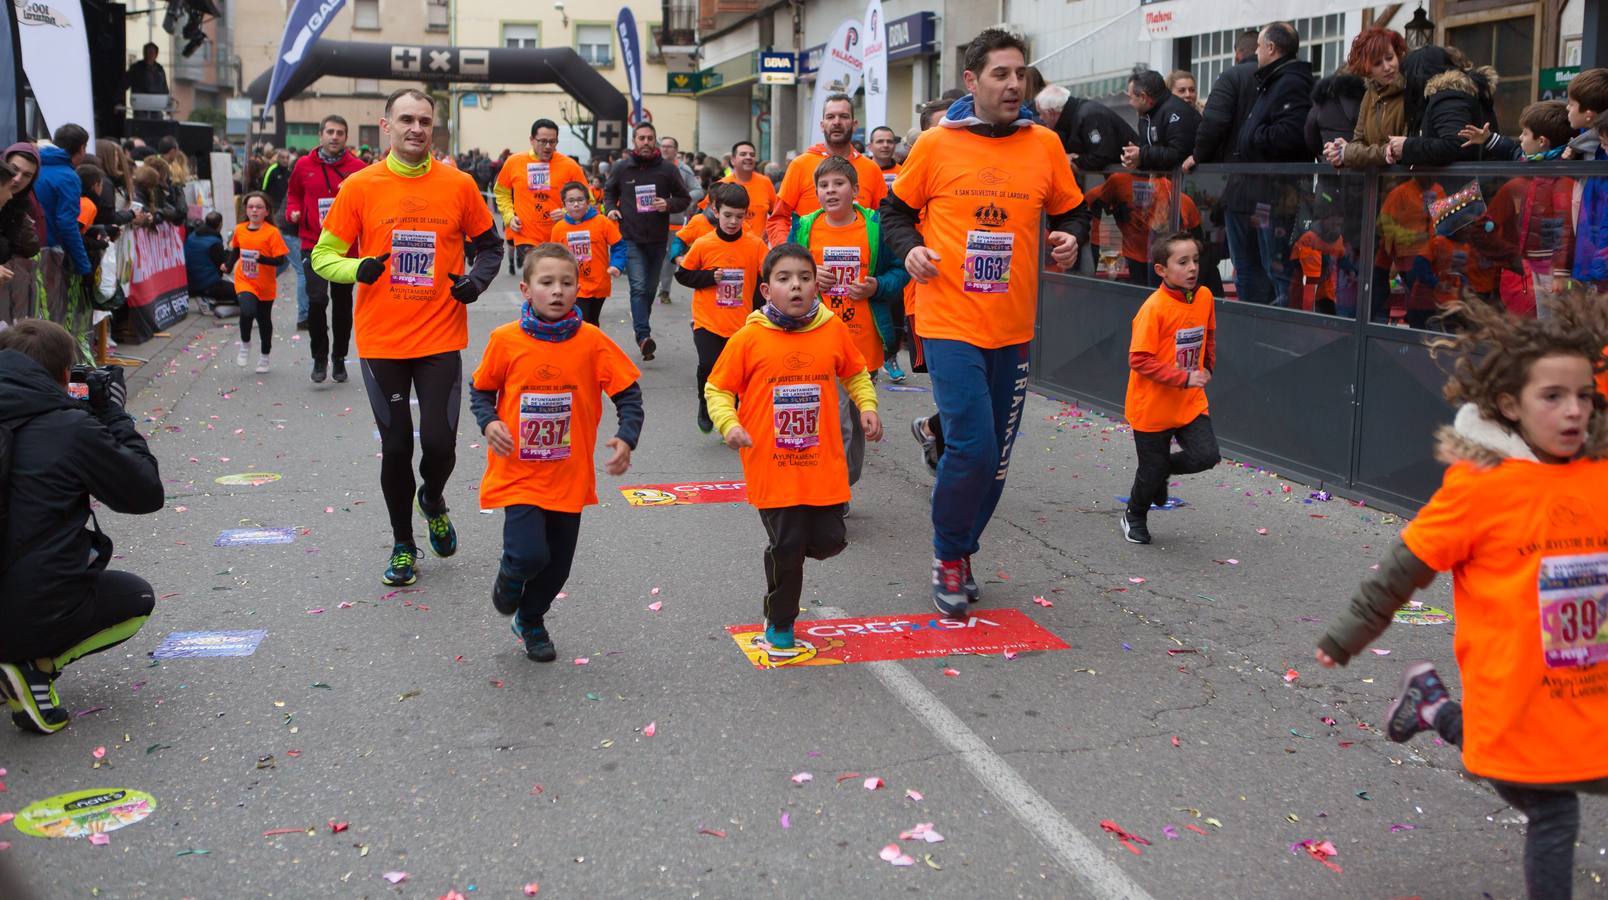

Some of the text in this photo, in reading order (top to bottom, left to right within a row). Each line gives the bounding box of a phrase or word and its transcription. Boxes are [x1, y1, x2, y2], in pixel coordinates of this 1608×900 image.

[1146, 11, 1172, 24] Mahou
[764, 57, 791, 68] BBVA
[398, 252, 429, 274] 1012
[974, 256, 1003, 281] 963
[527, 419, 566, 446] 237
[778, 409, 816, 436] 255
[994, 361, 1030, 481] FRANKLIN
[807, 616, 1001, 637] GREFUSA
[1561, 600, 1599, 643] 39
